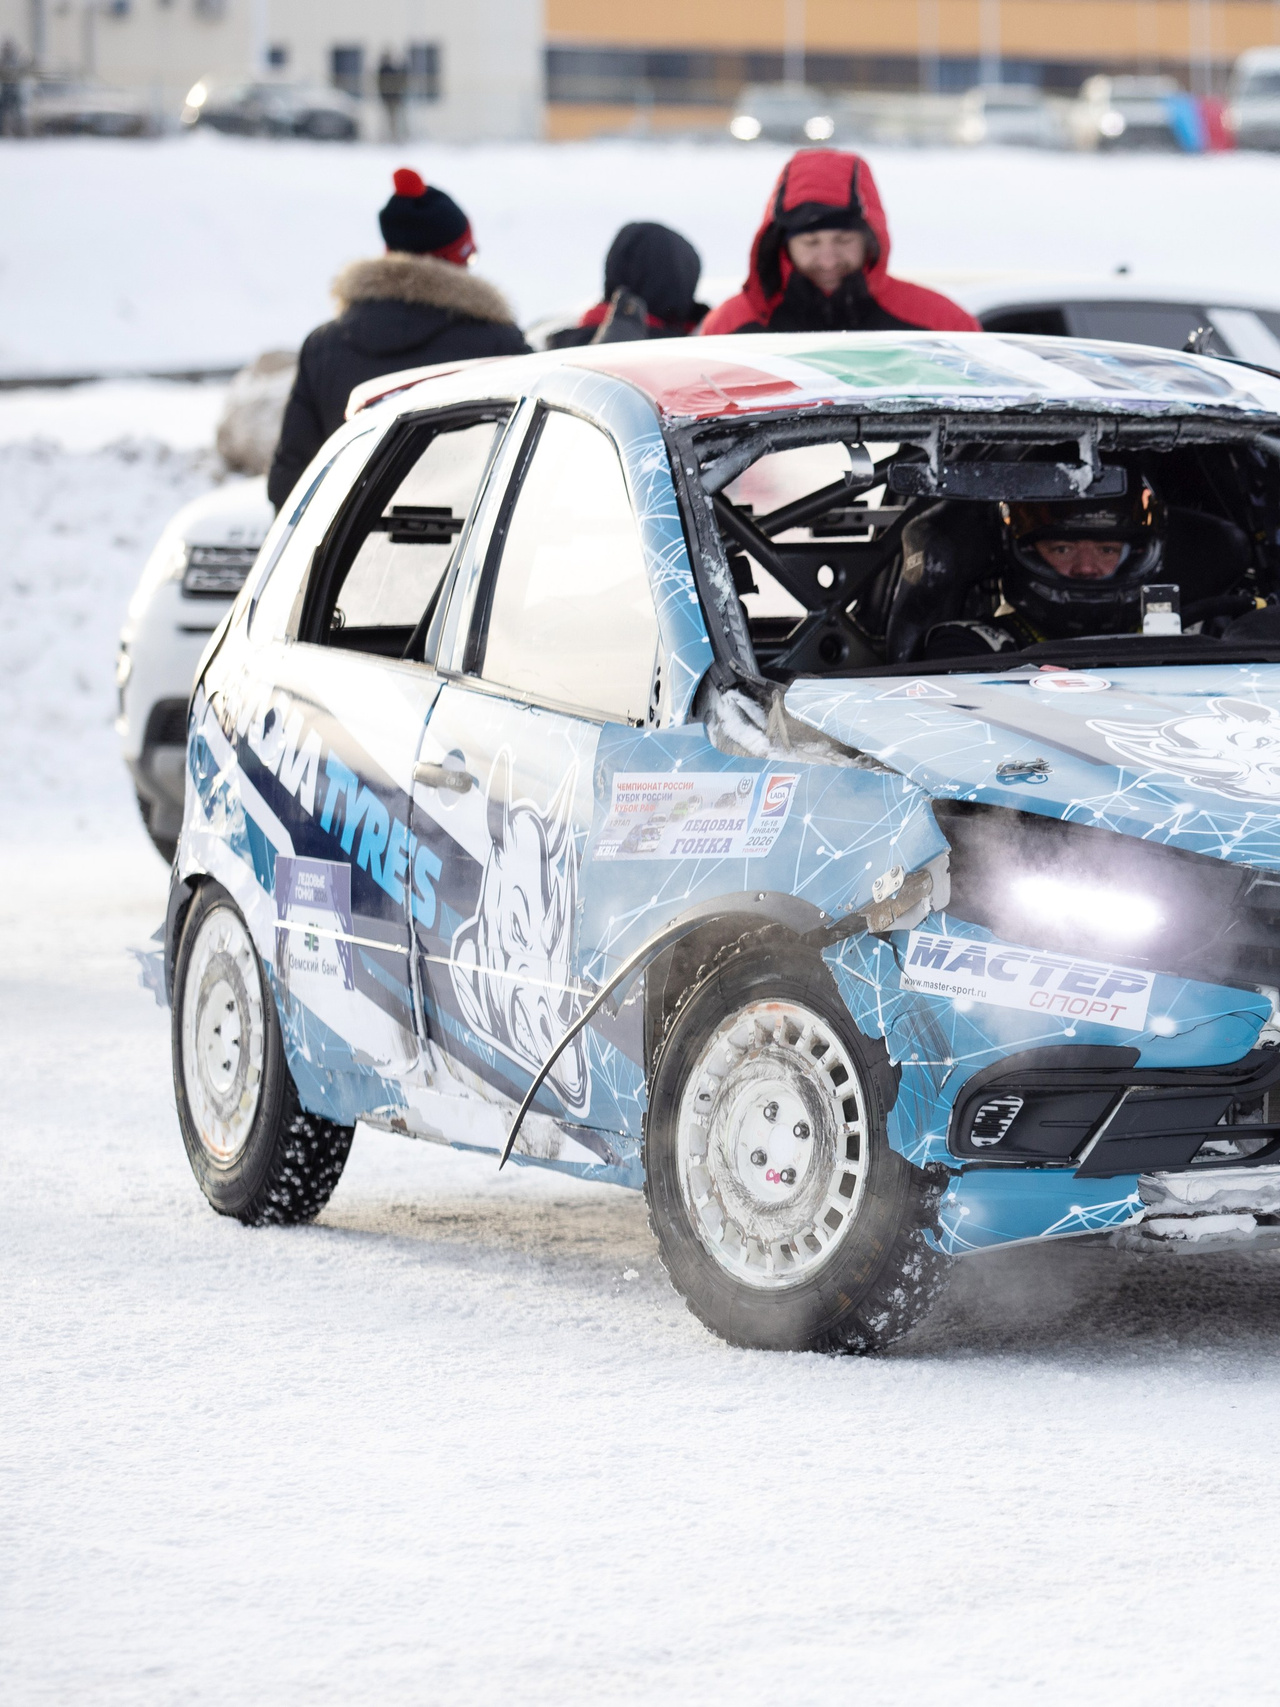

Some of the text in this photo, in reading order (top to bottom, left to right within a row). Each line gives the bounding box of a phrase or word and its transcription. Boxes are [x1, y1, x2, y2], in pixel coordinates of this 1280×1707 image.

[616, 781, 695, 791] ЧЕМПИОНАТ РОССИИ
[616, 792, 673, 802] КУБОК РОССИИ
[769, 792, 786, 800] LADA
[614, 803, 657, 813] КУБОК РАФ
[681, 818, 746, 833] ЛЕДОВАЯ
[319, 749, 443, 930] TYRES
[669, 837, 733, 855] ГОНКА
[745, 836, 774, 847] 2026
[596, 845, 620, 858] КВЦ
[297, 871, 326, 889] ЛЕДОВЫЕ
[294, 884, 314, 902] ГОНКИ
[289, 952, 338, 977] Земский банк
[908, 936, 1149, 1000] МАСТЕР
[904, 976, 987, 999] www.master-sport.ru
[1029, 990, 1127, 1022] СПОРТ
